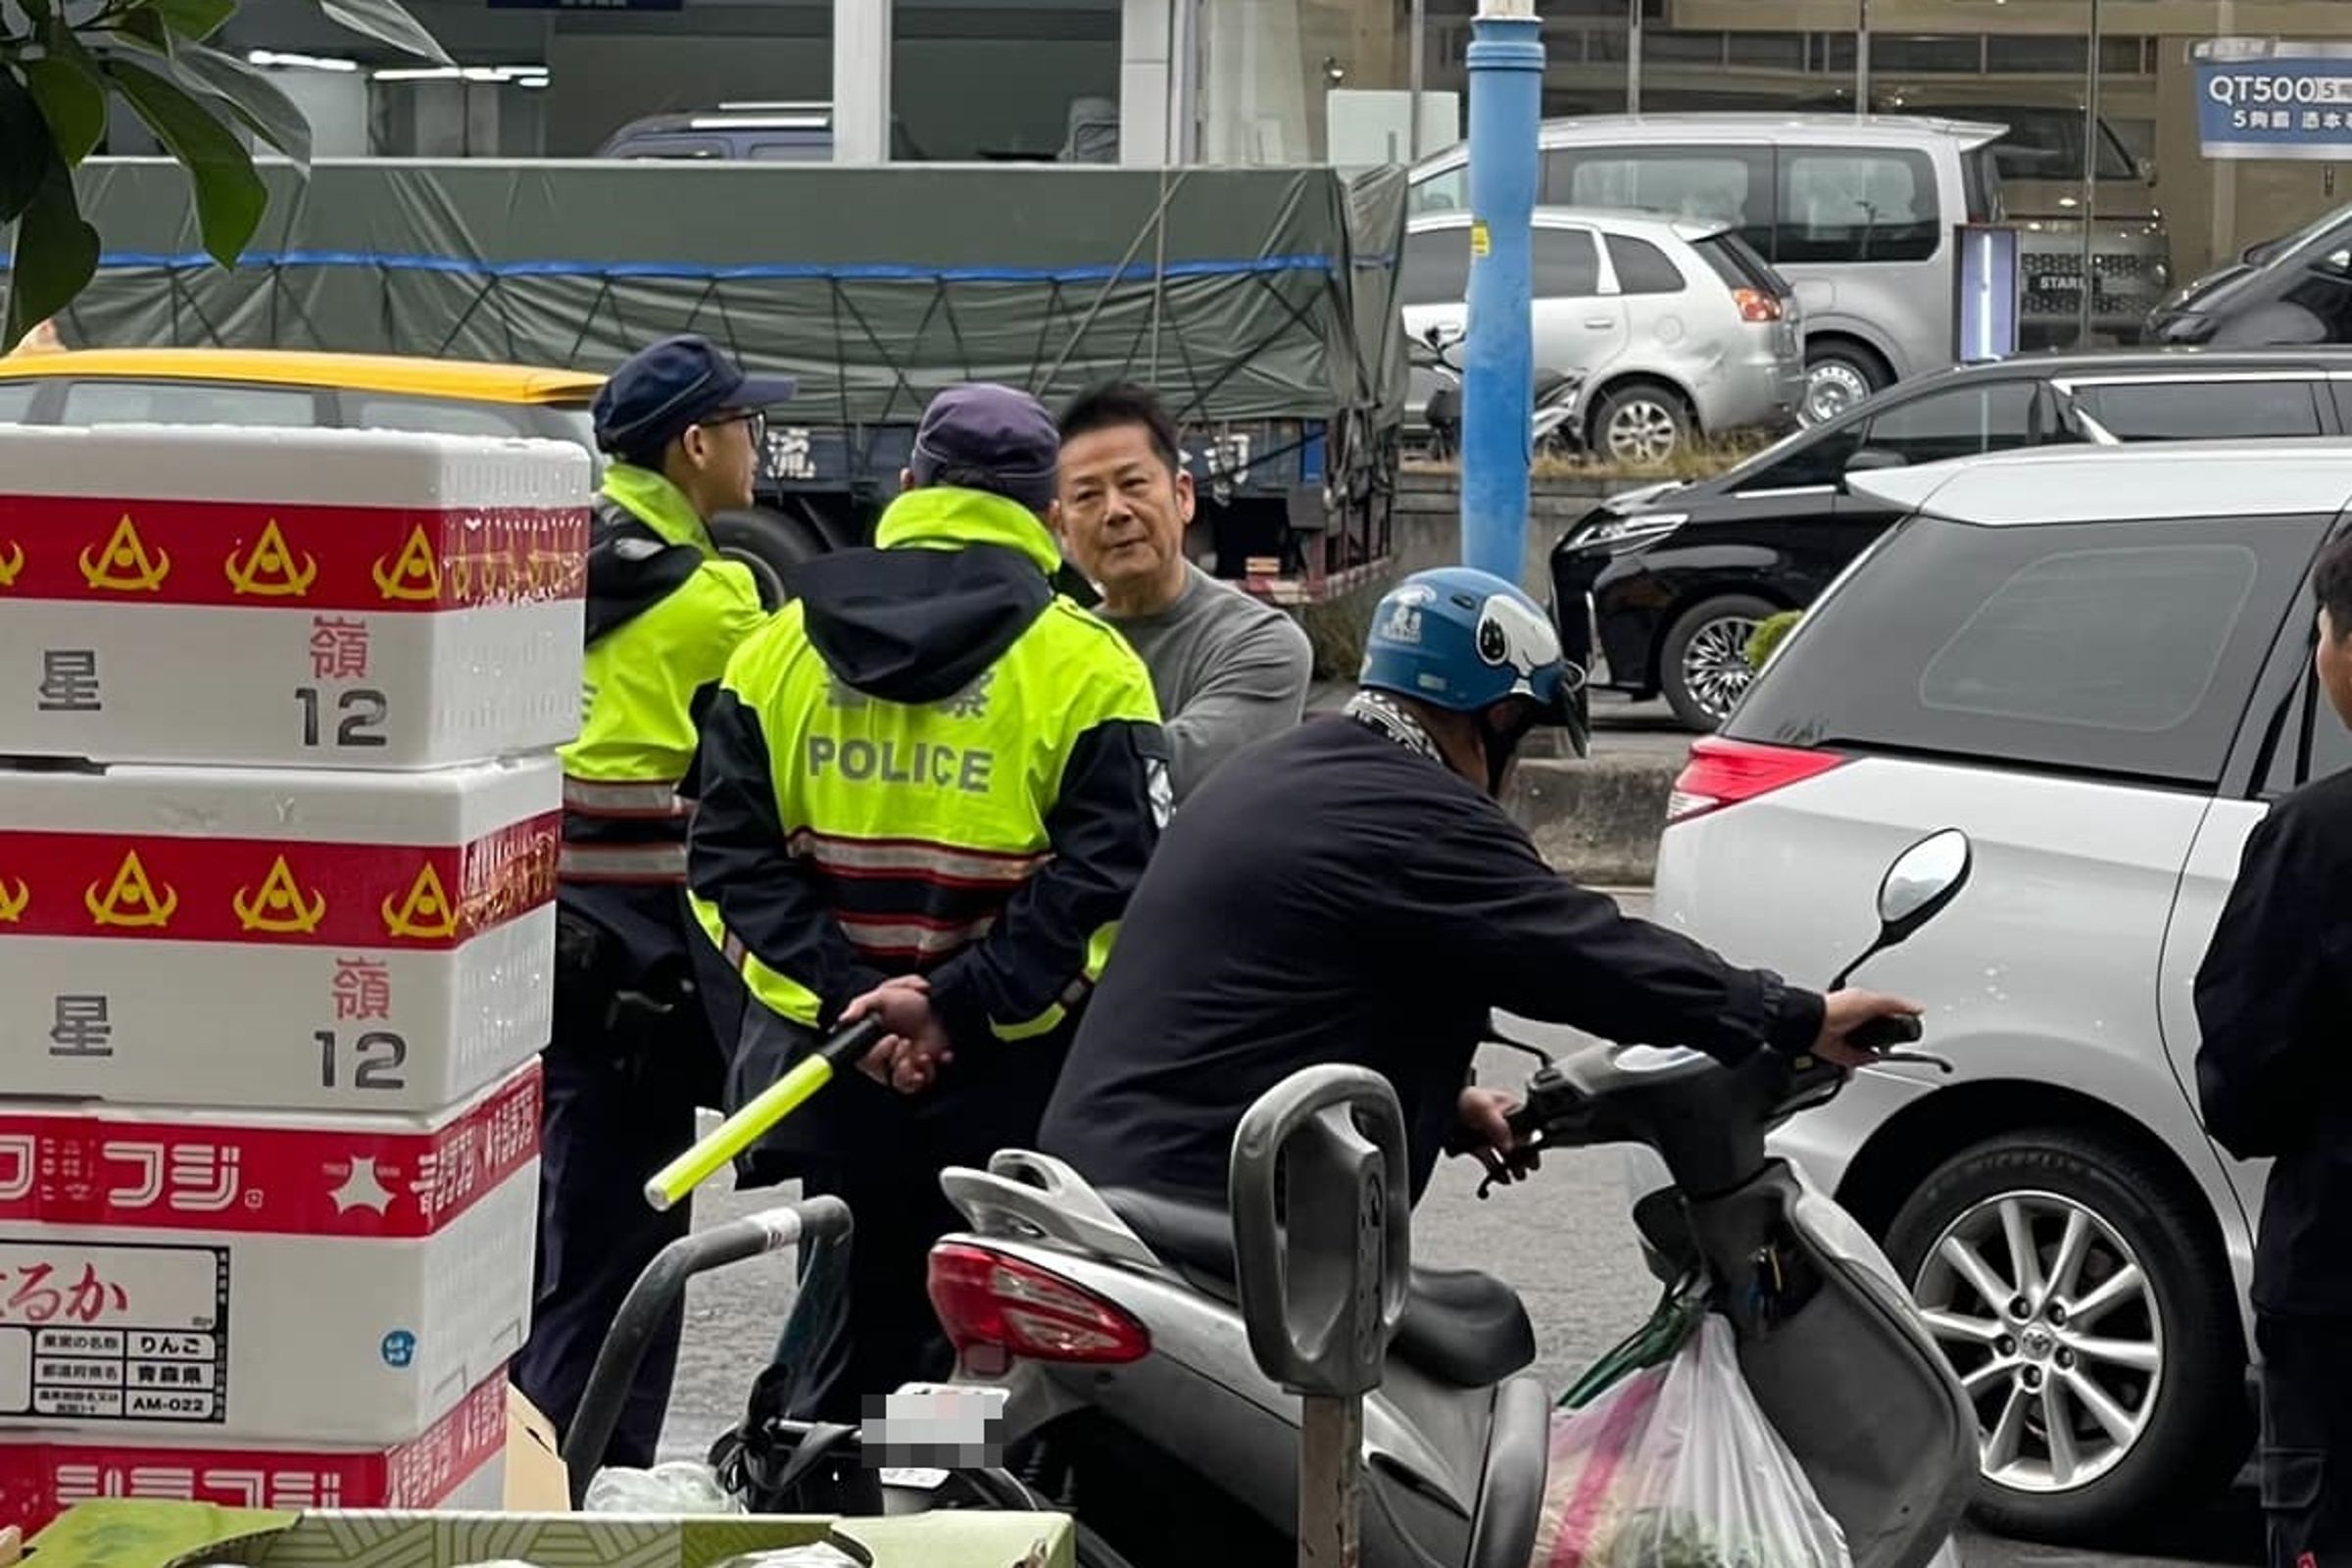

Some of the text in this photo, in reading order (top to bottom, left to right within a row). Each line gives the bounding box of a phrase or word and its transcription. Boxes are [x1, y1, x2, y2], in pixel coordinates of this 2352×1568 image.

[2209, 75, 2316, 106] QT500
[310, 615, 369, 678] 嶺
[38, 651, 102, 710] 星
[295, 688, 387, 746] 12
[808, 736, 994, 793] POLICE
[331, 956, 389, 1019] 嶺
[50, 996, 113, 1056] 星
[315, 1031, 407, 1089] 12
[103, 1141, 241, 1211] フジ
[0, 1262, 127, 1321] るか
[133, 1396, 204, 1413] AM-022
